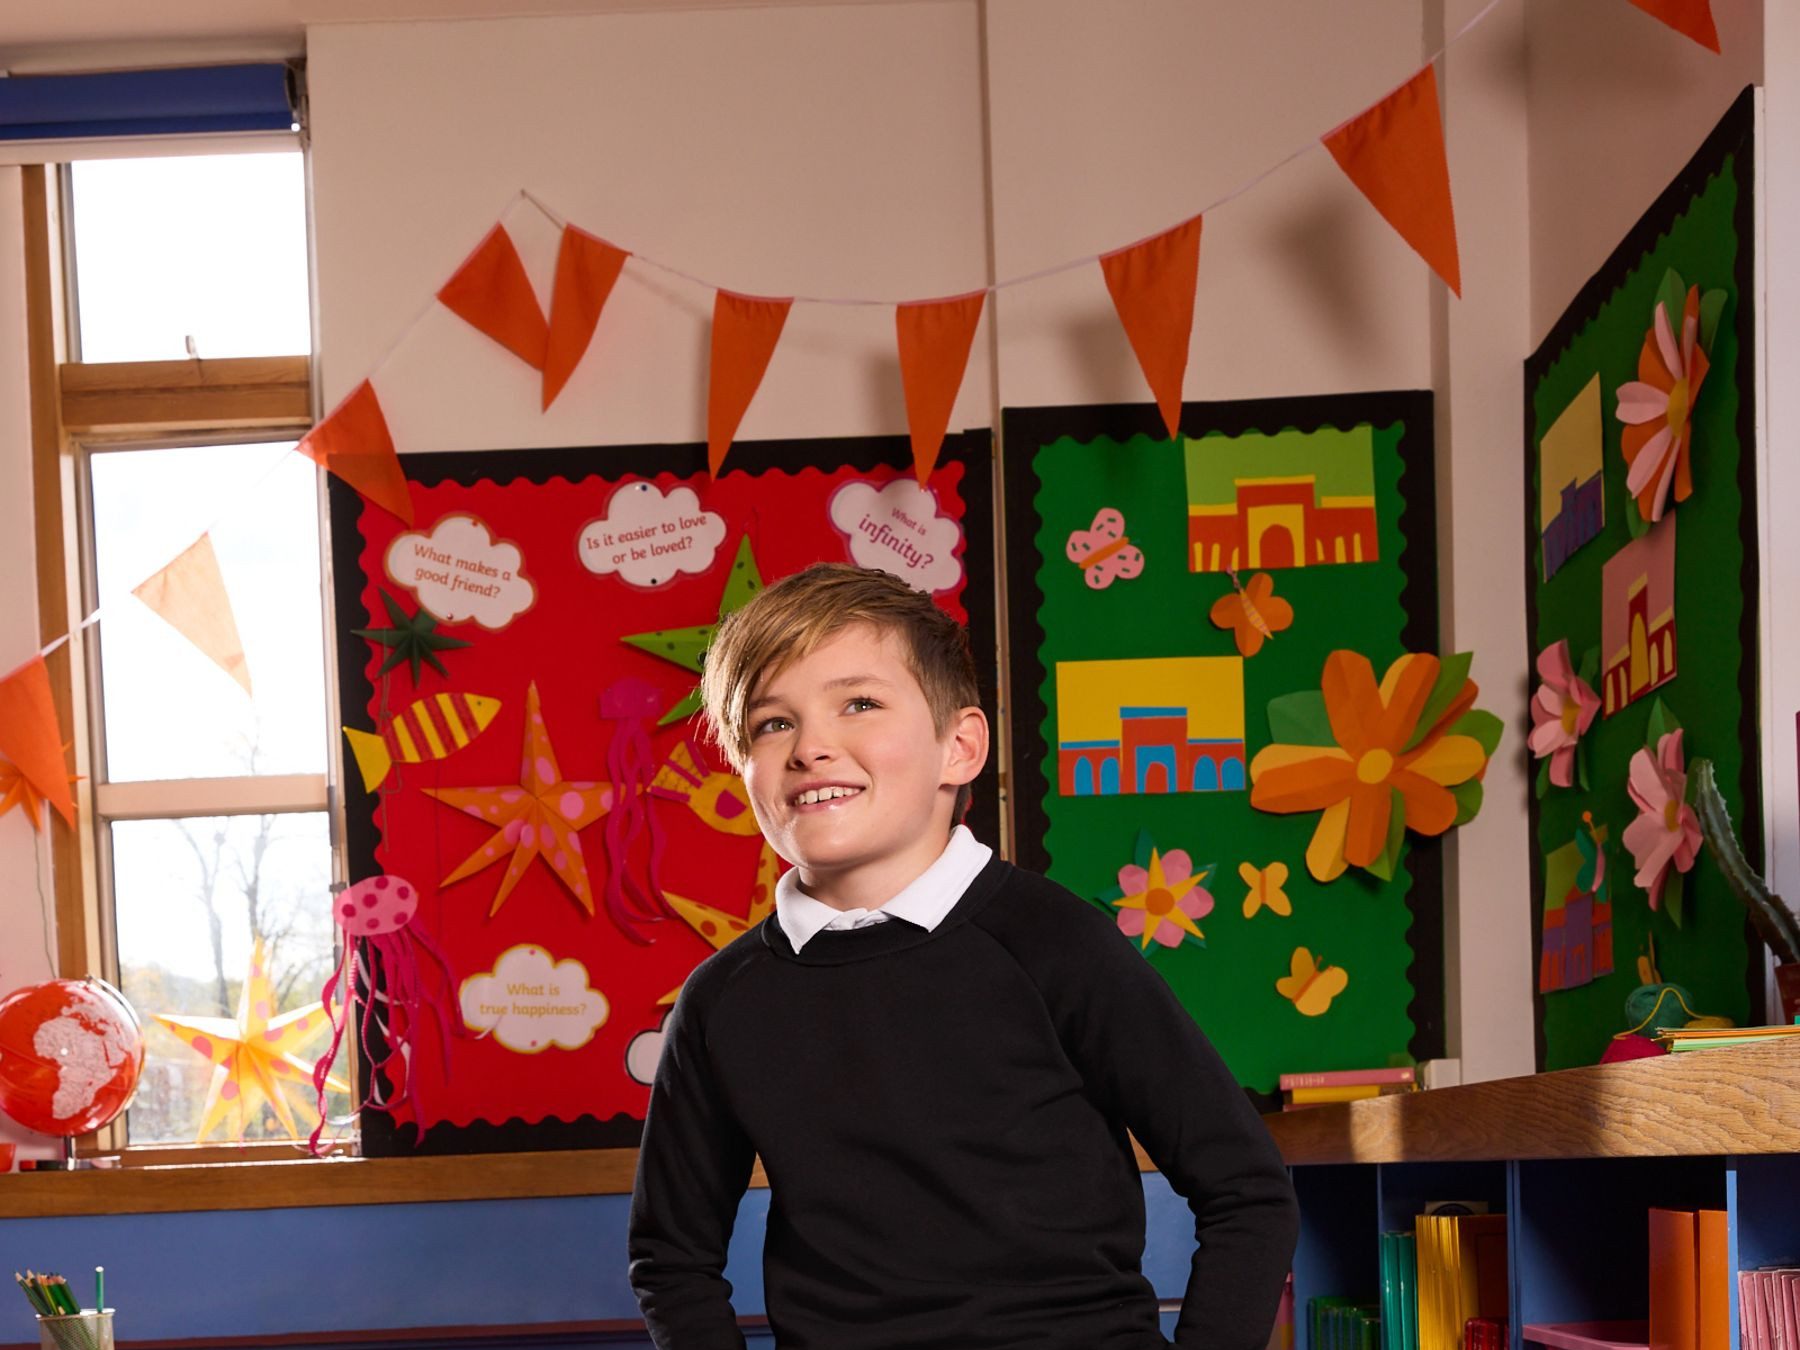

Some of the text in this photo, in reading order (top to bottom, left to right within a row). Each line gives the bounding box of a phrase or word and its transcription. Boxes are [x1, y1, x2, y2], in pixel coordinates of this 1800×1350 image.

[586, 515, 707, 550] Is it easier to love
[891, 508, 927, 536] What is
[612, 536, 693, 565] or be loved?
[859, 513, 934, 569] infinity?
[414, 543, 511, 581] What makes a
[415, 567, 501, 598] good friend?
[507, 983, 560, 996] What is
[479, 1002, 587, 1018] true happiness?
